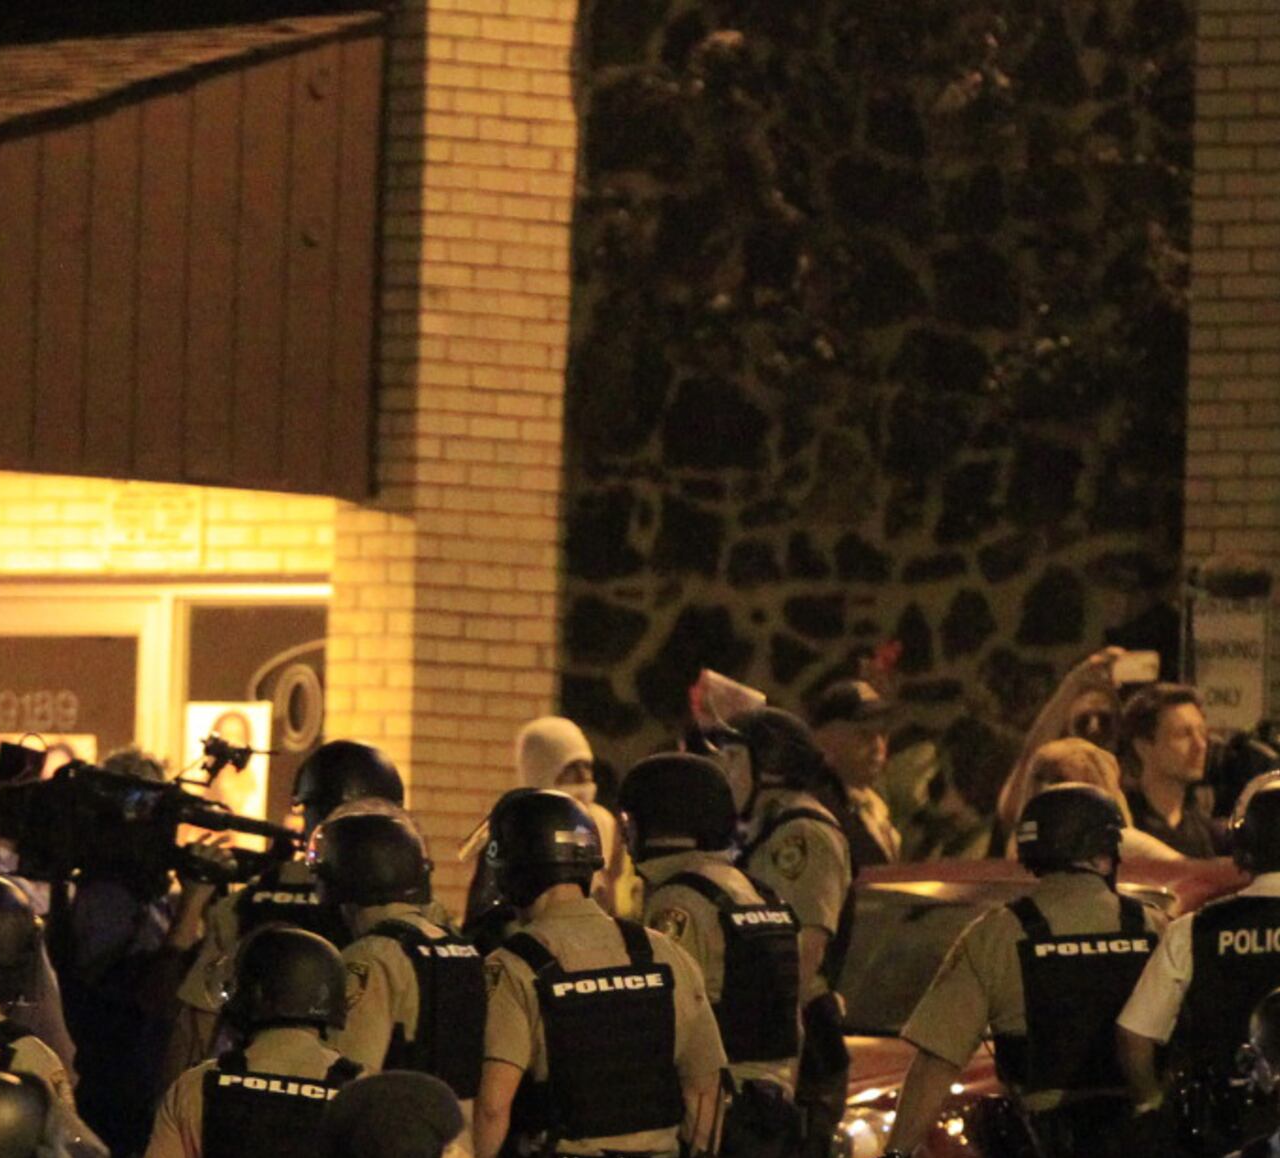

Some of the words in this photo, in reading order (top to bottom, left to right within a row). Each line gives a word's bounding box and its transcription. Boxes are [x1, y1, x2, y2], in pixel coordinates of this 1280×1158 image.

[252, 890, 320, 905] POLI
[730, 909, 793, 926] POLICE
[1035, 939, 1150, 957] POLICE
[552, 972, 664, 997] POLICE
